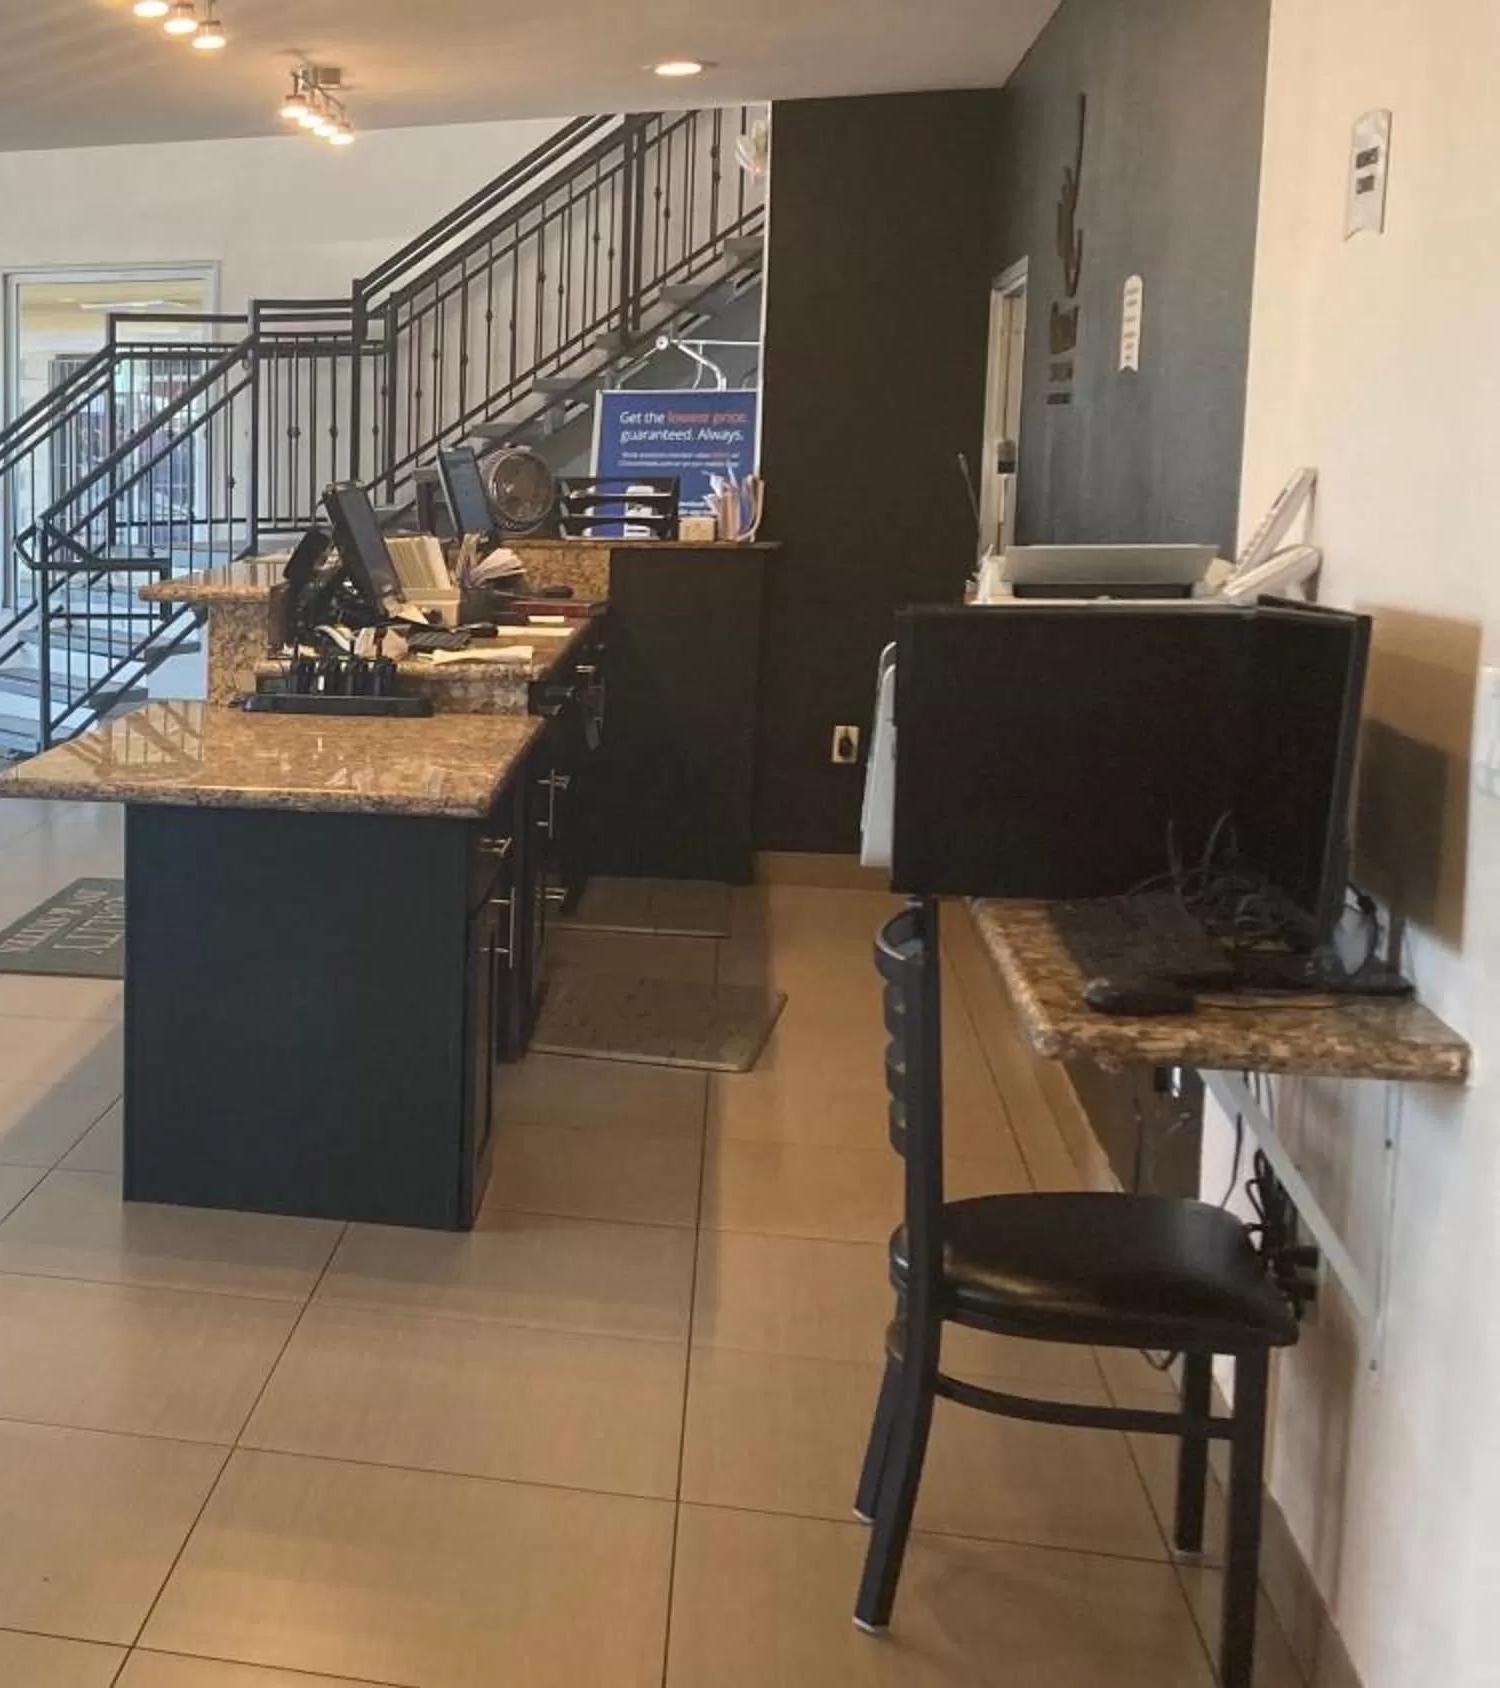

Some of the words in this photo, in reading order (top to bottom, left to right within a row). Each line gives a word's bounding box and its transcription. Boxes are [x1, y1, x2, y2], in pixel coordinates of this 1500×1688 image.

[619, 411, 642, 424] Get
[644, 411, 665, 424] the
[697, 427, 744, 444] Always.
